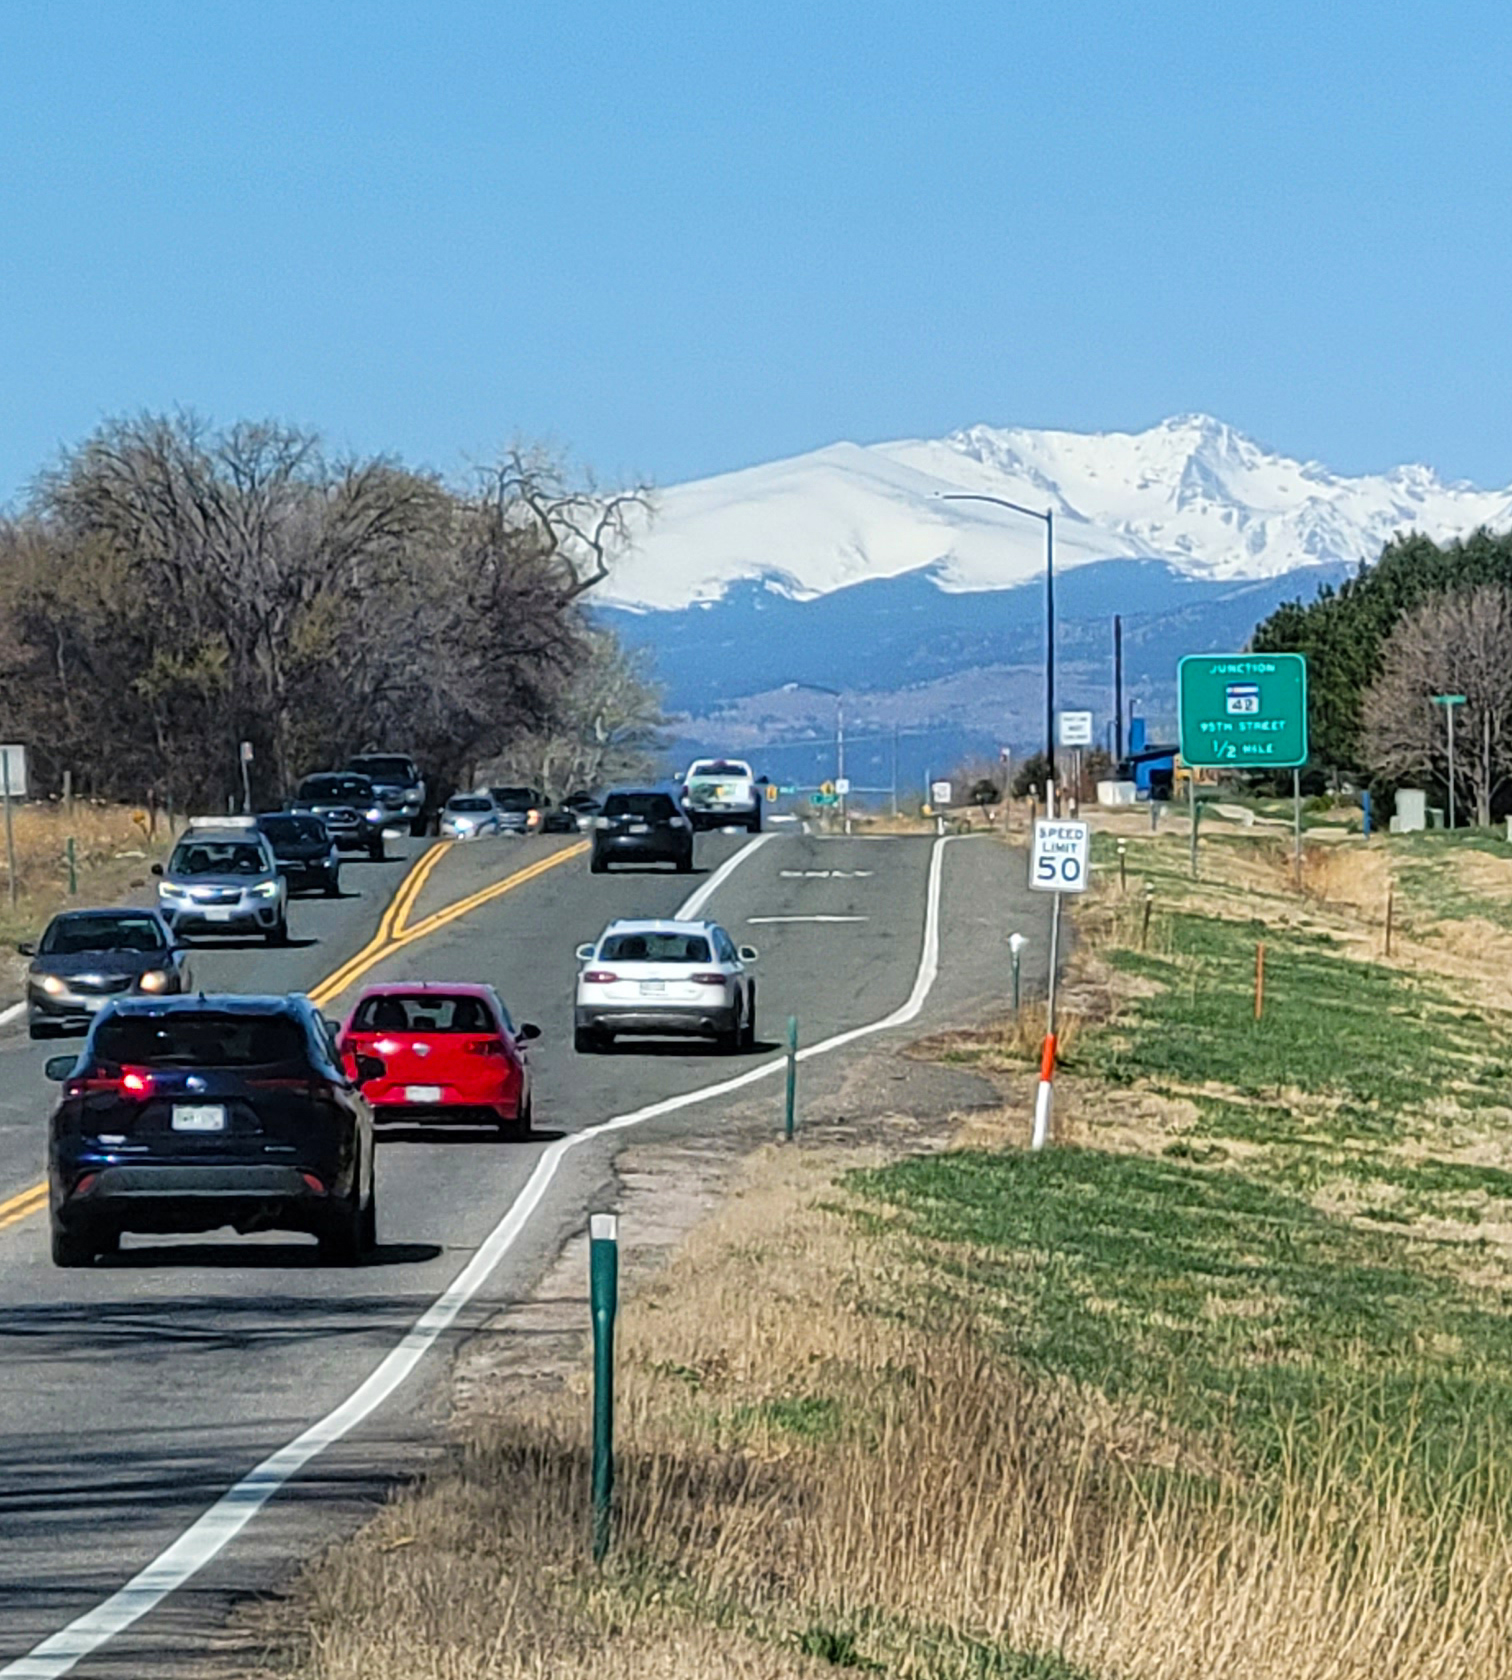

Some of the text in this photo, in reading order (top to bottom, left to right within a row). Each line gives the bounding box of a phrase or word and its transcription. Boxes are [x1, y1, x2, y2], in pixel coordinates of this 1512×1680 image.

[1209, 663, 1276, 675] JUNCTION
[1231, 698, 1253, 711] 42
[1200, 720, 1286, 733] 95TH STREET
[1212, 740, 1274, 759] 1/2 MILE
[1039, 827, 1084, 840] SPEED
[1042, 842, 1077, 853] LIMIT
[1036, 856, 1080, 882] 50
